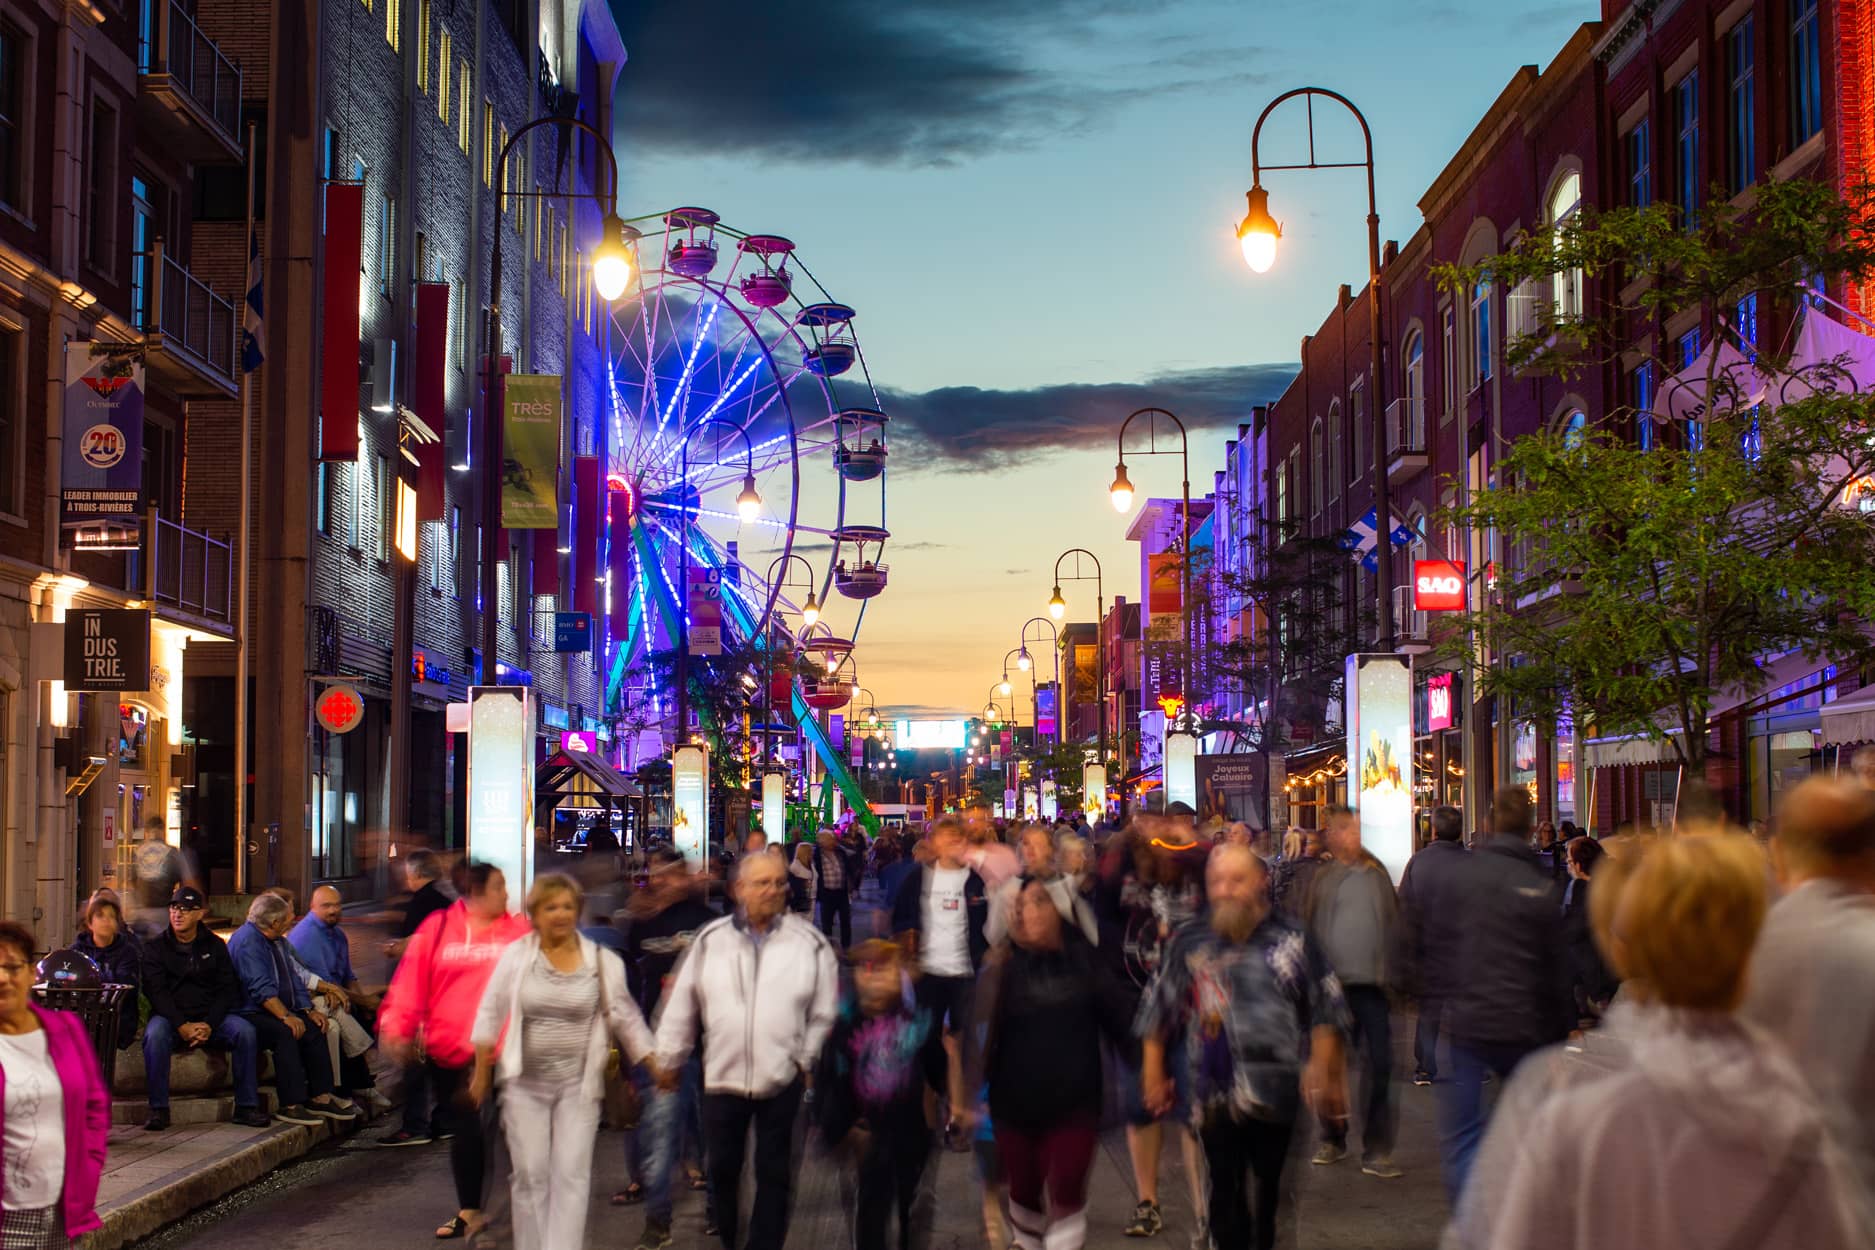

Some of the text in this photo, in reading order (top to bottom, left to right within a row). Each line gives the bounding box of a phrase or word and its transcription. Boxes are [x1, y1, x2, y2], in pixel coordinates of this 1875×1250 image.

[64, 491, 138, 501] LEADER IMMOBILIER
[67, 501, 134, 513] À TROIS-RIVIÈRES
[84, 618, 100, 637] IN
[84, 638, 117, 657] DUS
[84, 658, 126, 677] TRIE.
[1215, 765, 1250, 774] Joyeux
[1211, 772, 1253, 782] Calvaire
